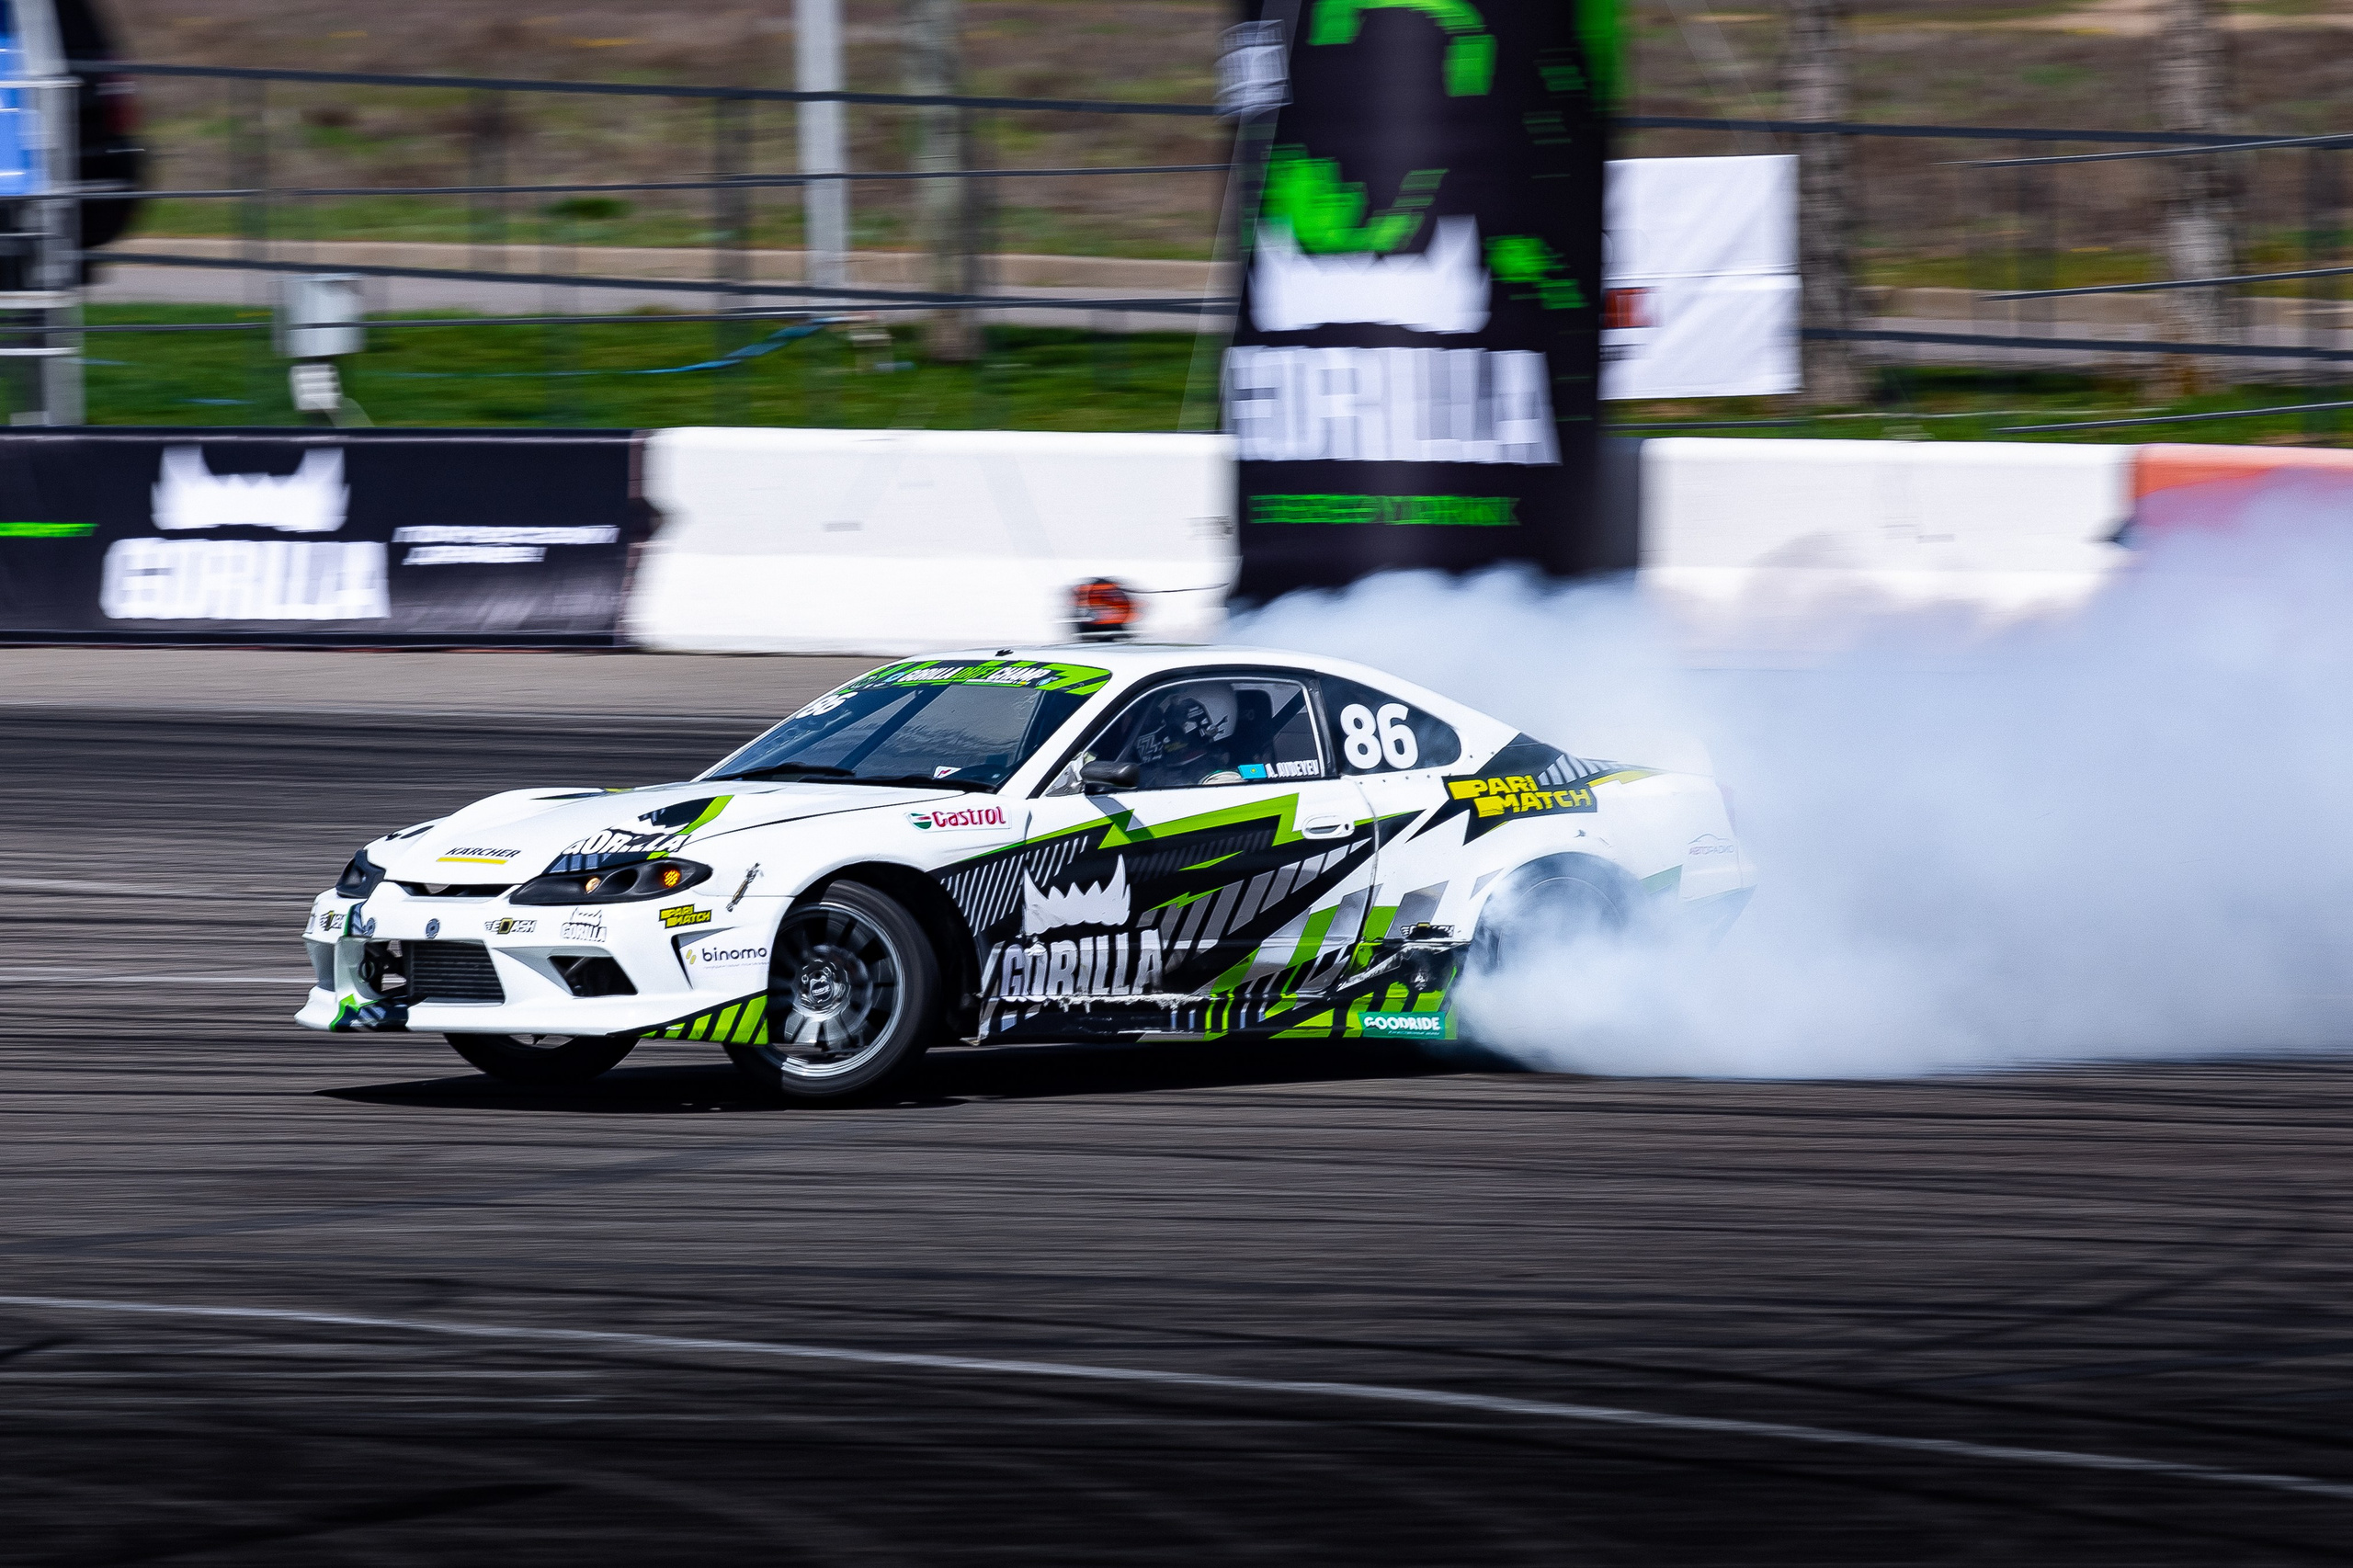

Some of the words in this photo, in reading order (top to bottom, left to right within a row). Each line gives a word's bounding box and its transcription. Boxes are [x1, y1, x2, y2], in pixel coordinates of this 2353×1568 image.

[1340, 703, 1418, 769] 86
[1449, 775, 1539, 801] PARI
[932, 806, 1006, 827] Castrol
[1474, 789, 1593, 818] MATCH
[701, 947, 767, 962] binomo
[1000, 928, 1164, 998] GORILLA
[1364, 1016, 1441, 1030] GOODRIDE
